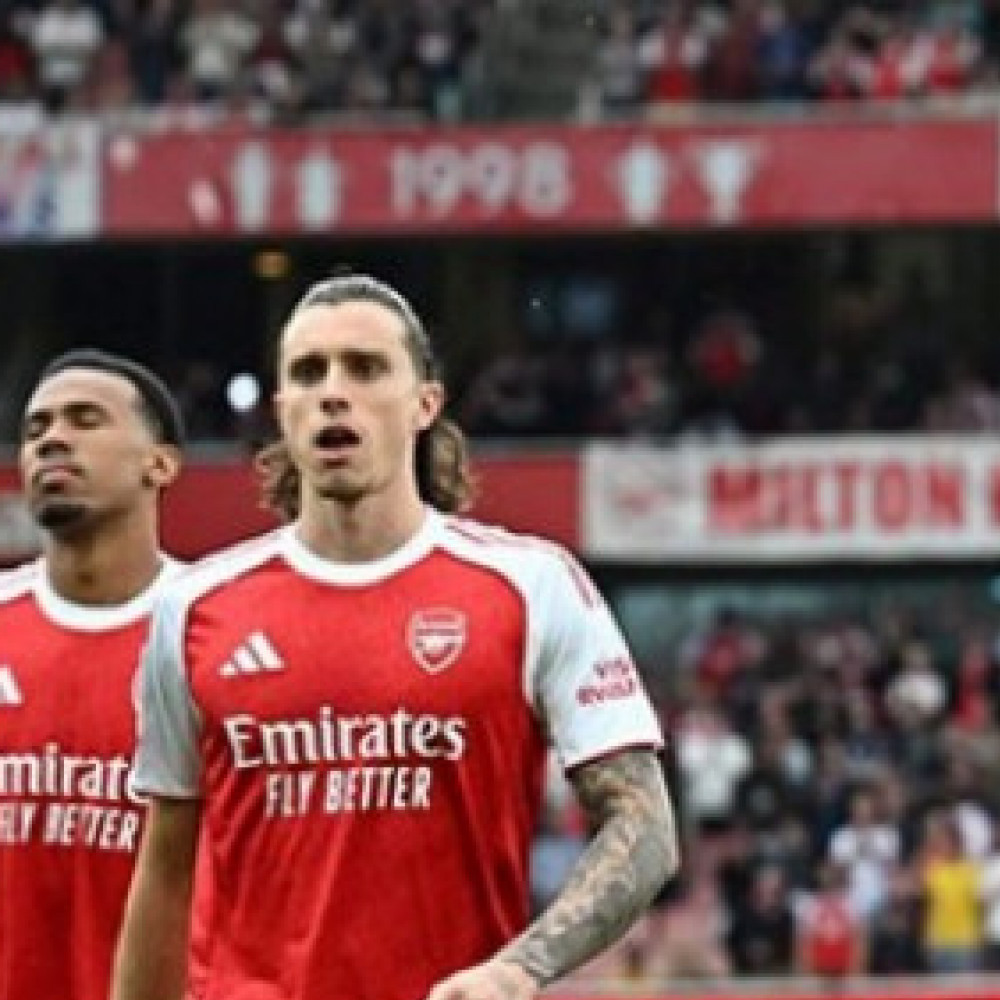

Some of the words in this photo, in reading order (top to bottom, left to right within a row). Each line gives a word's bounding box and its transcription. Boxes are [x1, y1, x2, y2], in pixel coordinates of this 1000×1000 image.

[390, 142, 572, 218] 1998
[223, 704, 466, 768] Emirates
[263, 769, 317, 818] FLY
[323, 764, 432, 813] BETTER
